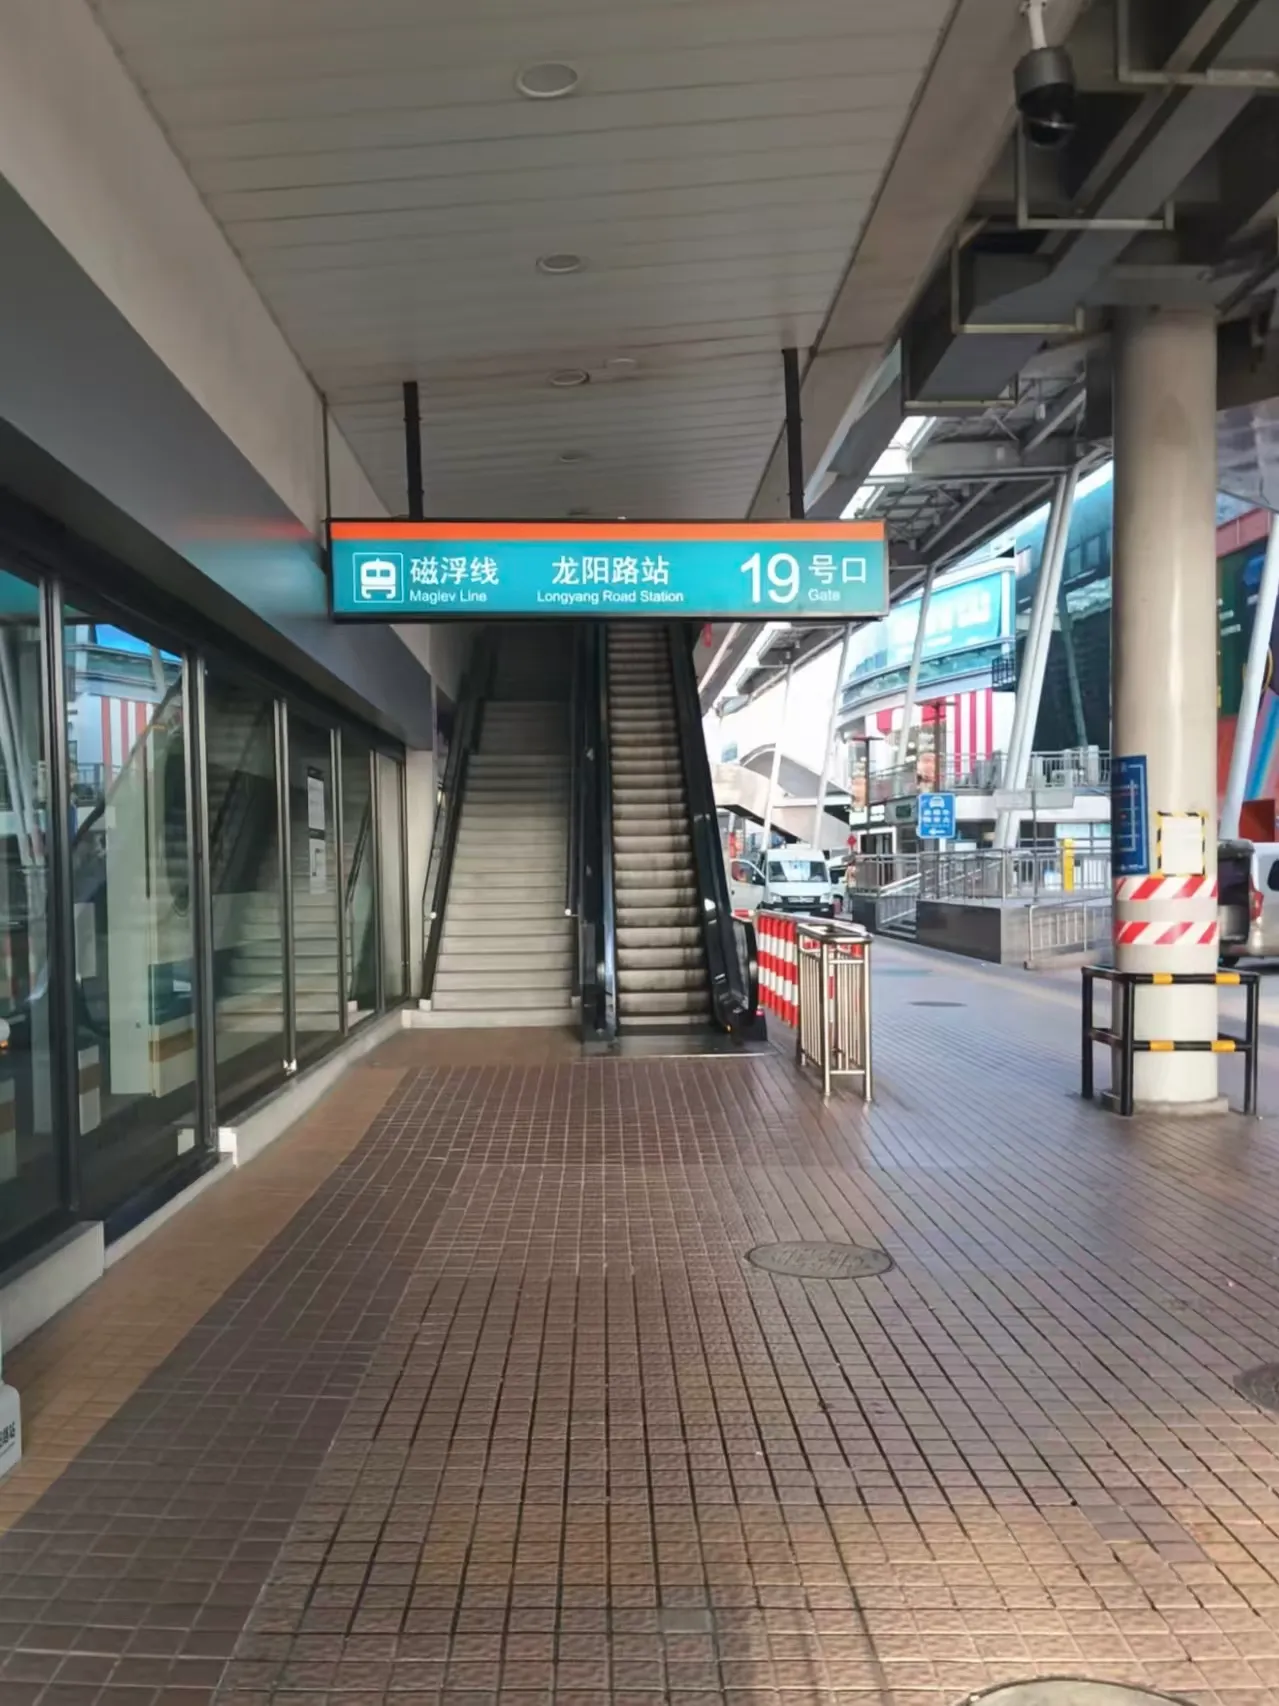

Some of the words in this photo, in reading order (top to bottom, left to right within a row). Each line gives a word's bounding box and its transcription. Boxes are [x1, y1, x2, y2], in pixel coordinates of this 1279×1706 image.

[409, 556, 500, 585] 磁浮线
[551, 554, 670, 585] 龙阳路站
[740, 552, 800, 604] 19
[808, 554, 867, 584] 号口
[409, 590, 456, 605] Maglev
[460, 589, 487, 602] Line
[536, 590, 599, 605] Longyang
[602, 590, 637, 602] Road
[640, 590, 684, 603] Station
[807, 588, 842, 602] Gate
